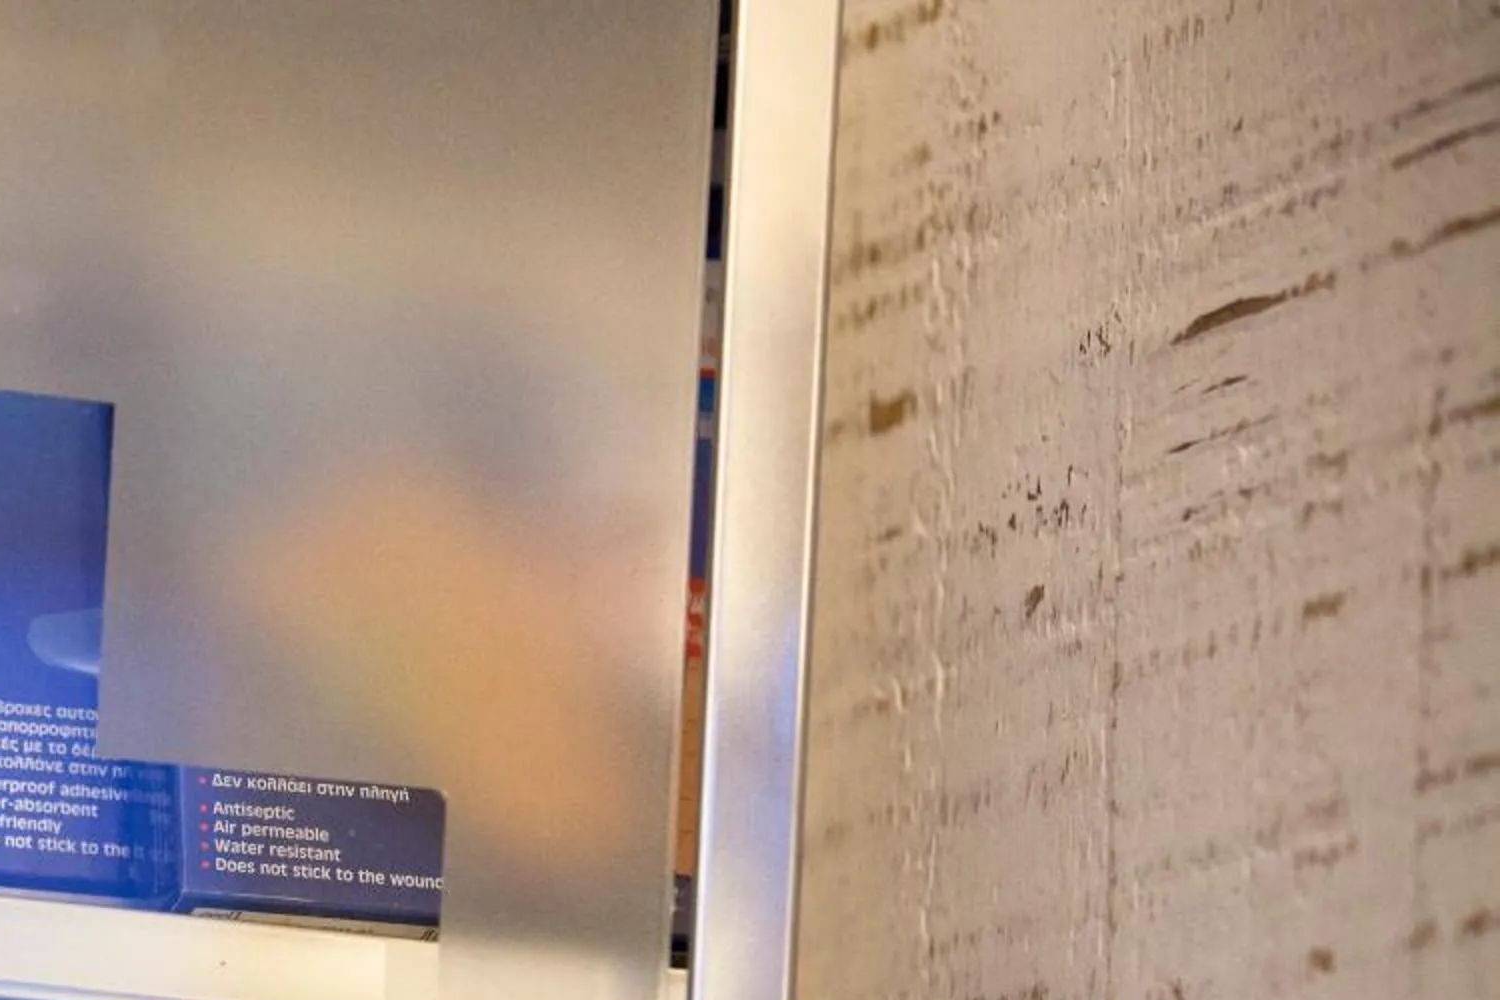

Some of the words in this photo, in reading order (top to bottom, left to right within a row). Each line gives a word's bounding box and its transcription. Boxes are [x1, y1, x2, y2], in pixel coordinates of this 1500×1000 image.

[48, 743, 67, 755] το
[211, 773, 243, 788] Δεν
[316, 784, 355, 798] στην
[213, 801, 296, 822] Antiseptic
[0, 815, 63, 833] friendly
[213, 821, 237, 834] Air
[241, 823, 330, 843] permeable
[4, 833, 33, 848] not
[38, 836, 77, 854] stick
[81, 841, 99, 855] to
[103, 843, 131, 858] the
[214, 840, 265, 856] Water
[269, 843, 342, 862] resistant
[215, 858, 255, 874] Does
[260, 863, 287, 877] not
[292, 864, 331, 880] stick
[336, 868, 353, 882] to
[358, 869, 385, 886] the
